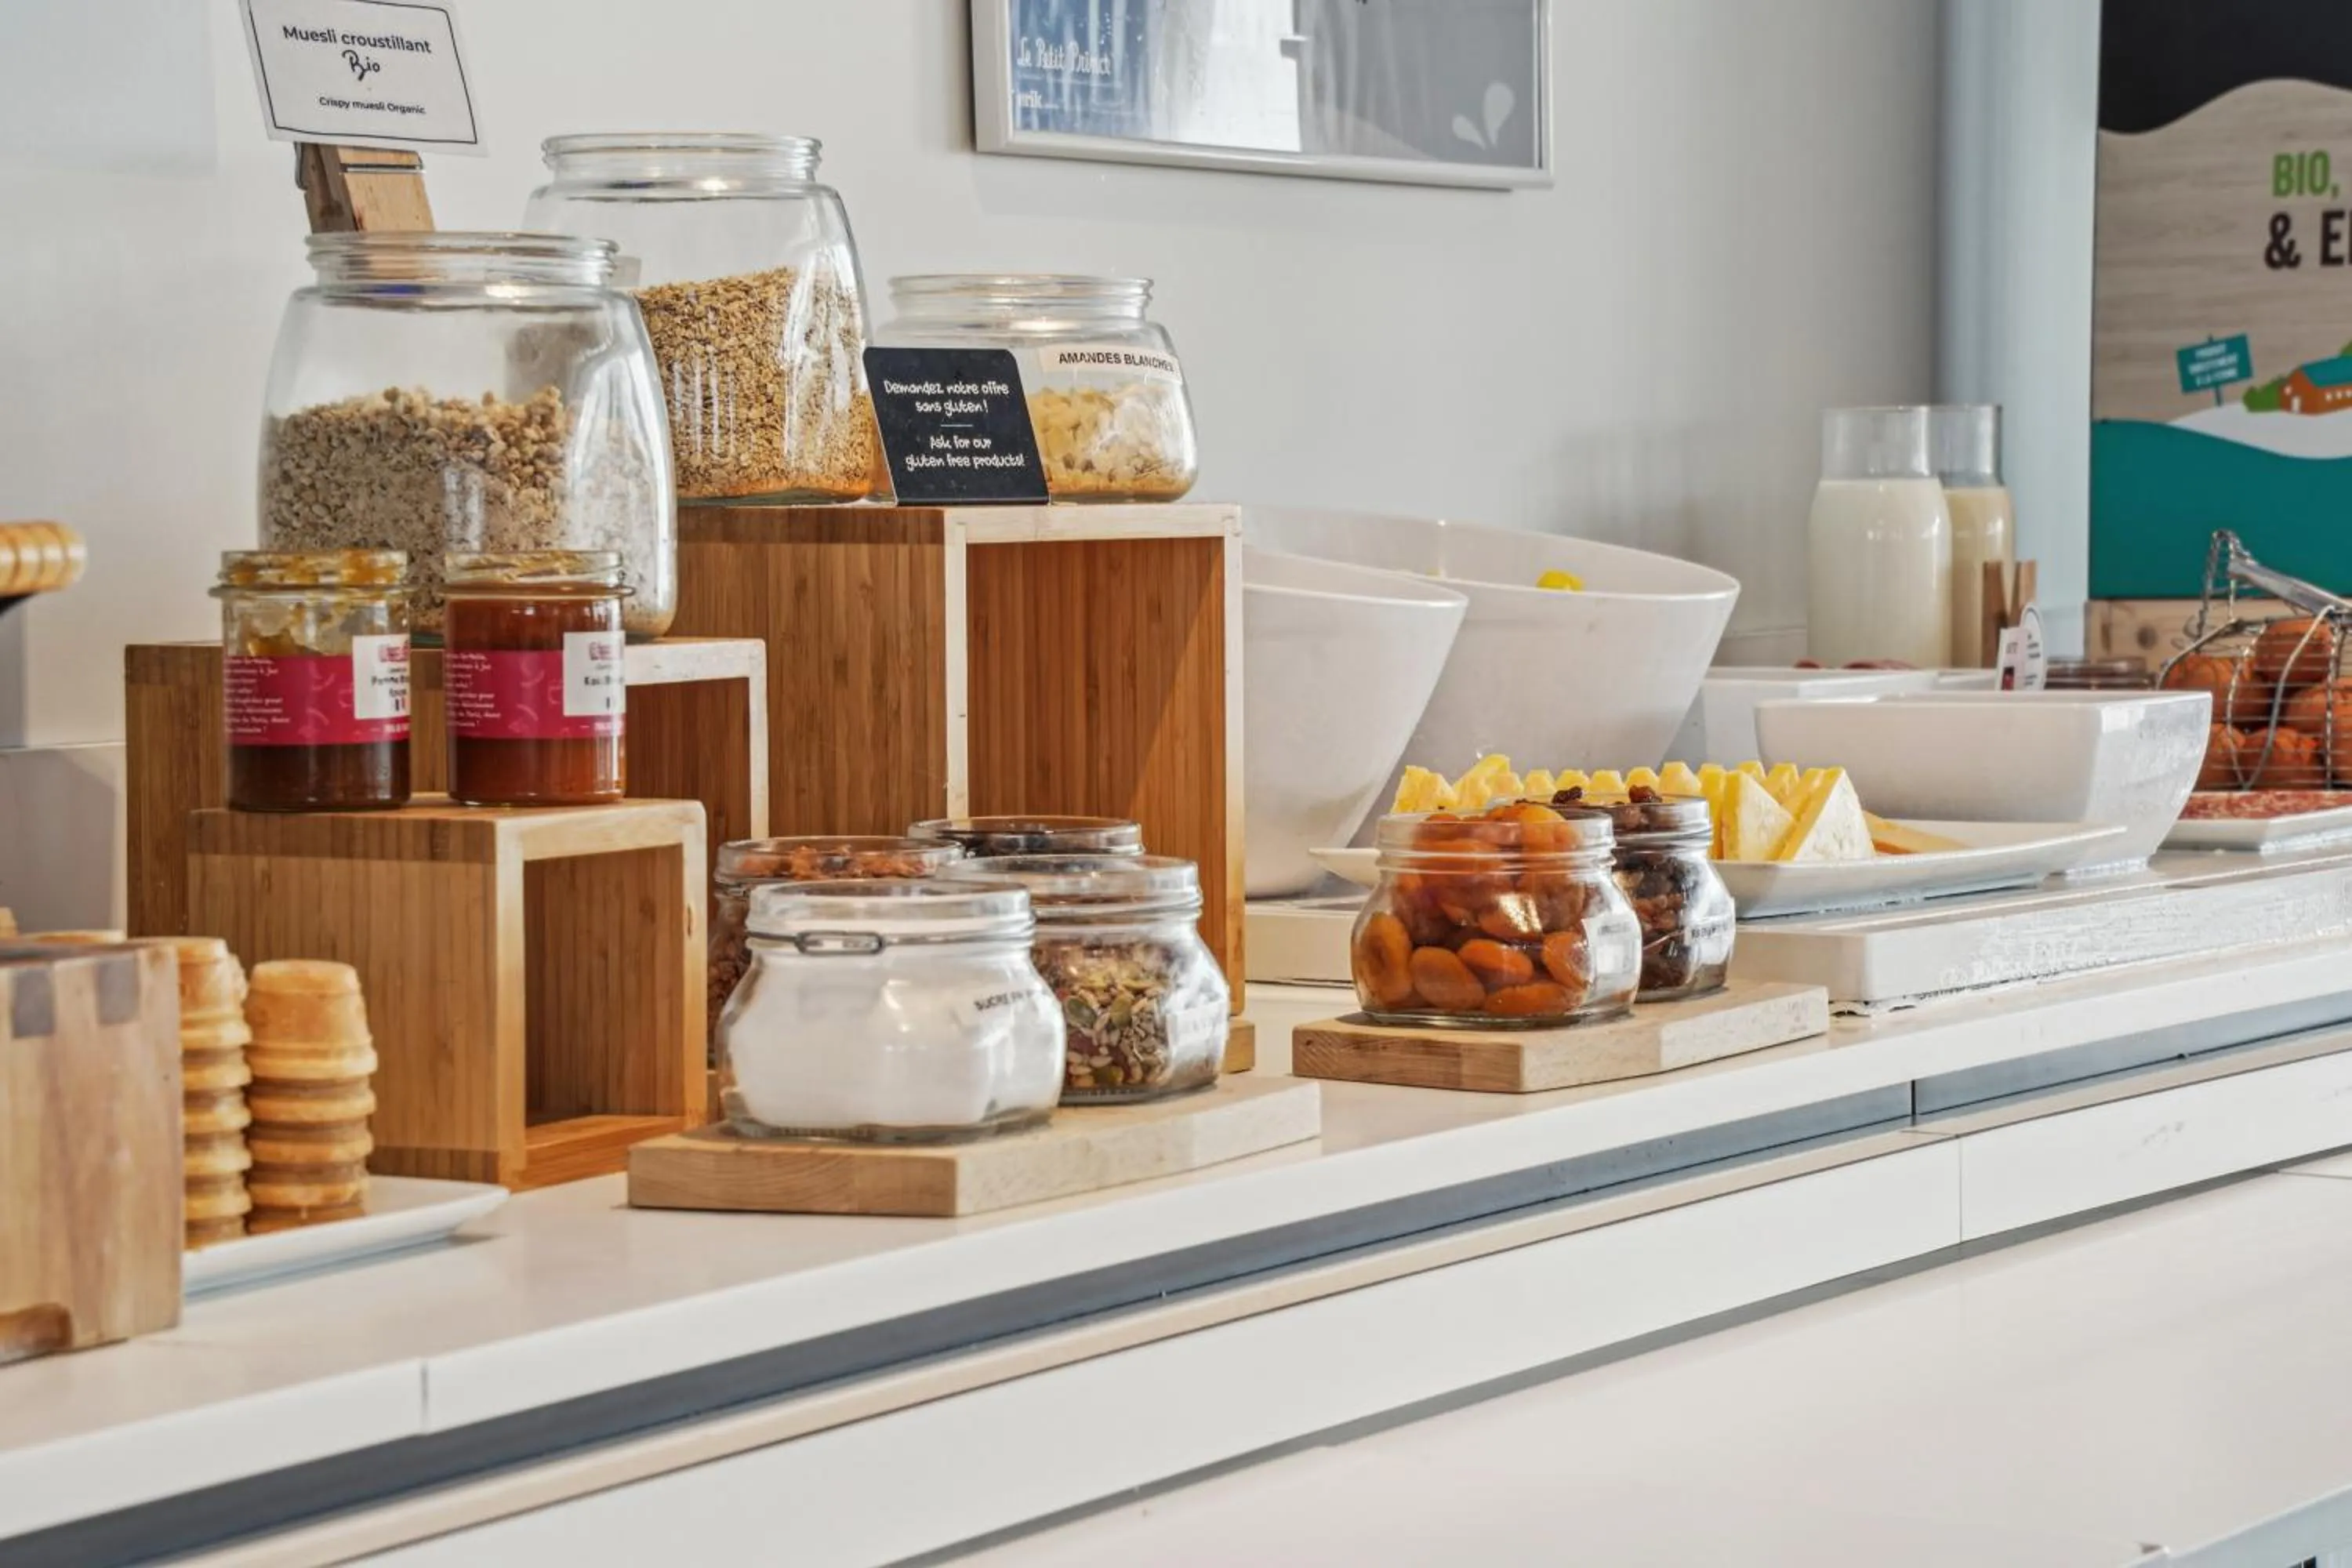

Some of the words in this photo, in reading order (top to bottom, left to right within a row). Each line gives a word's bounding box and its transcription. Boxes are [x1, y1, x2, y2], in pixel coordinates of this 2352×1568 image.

[283, 26, 337, 44] Muesli
[341, 34, 432, 53] croustillant
[342, 49, 380, 82] Bio
[319, 96, 350, 109] Crispy
[353, 100, 386, 111] muesli
[2274, 150, 2340, 200] BIO,
[2264, 212, 2301, 270] &
[2321, 209, 2352, 267] E
[1059, 352, 1121, 365] AMANDES
[884, 380, 944, 395] Demandez
[916, 400, 942, 412] sans
[953, 435, 971, 448] for
